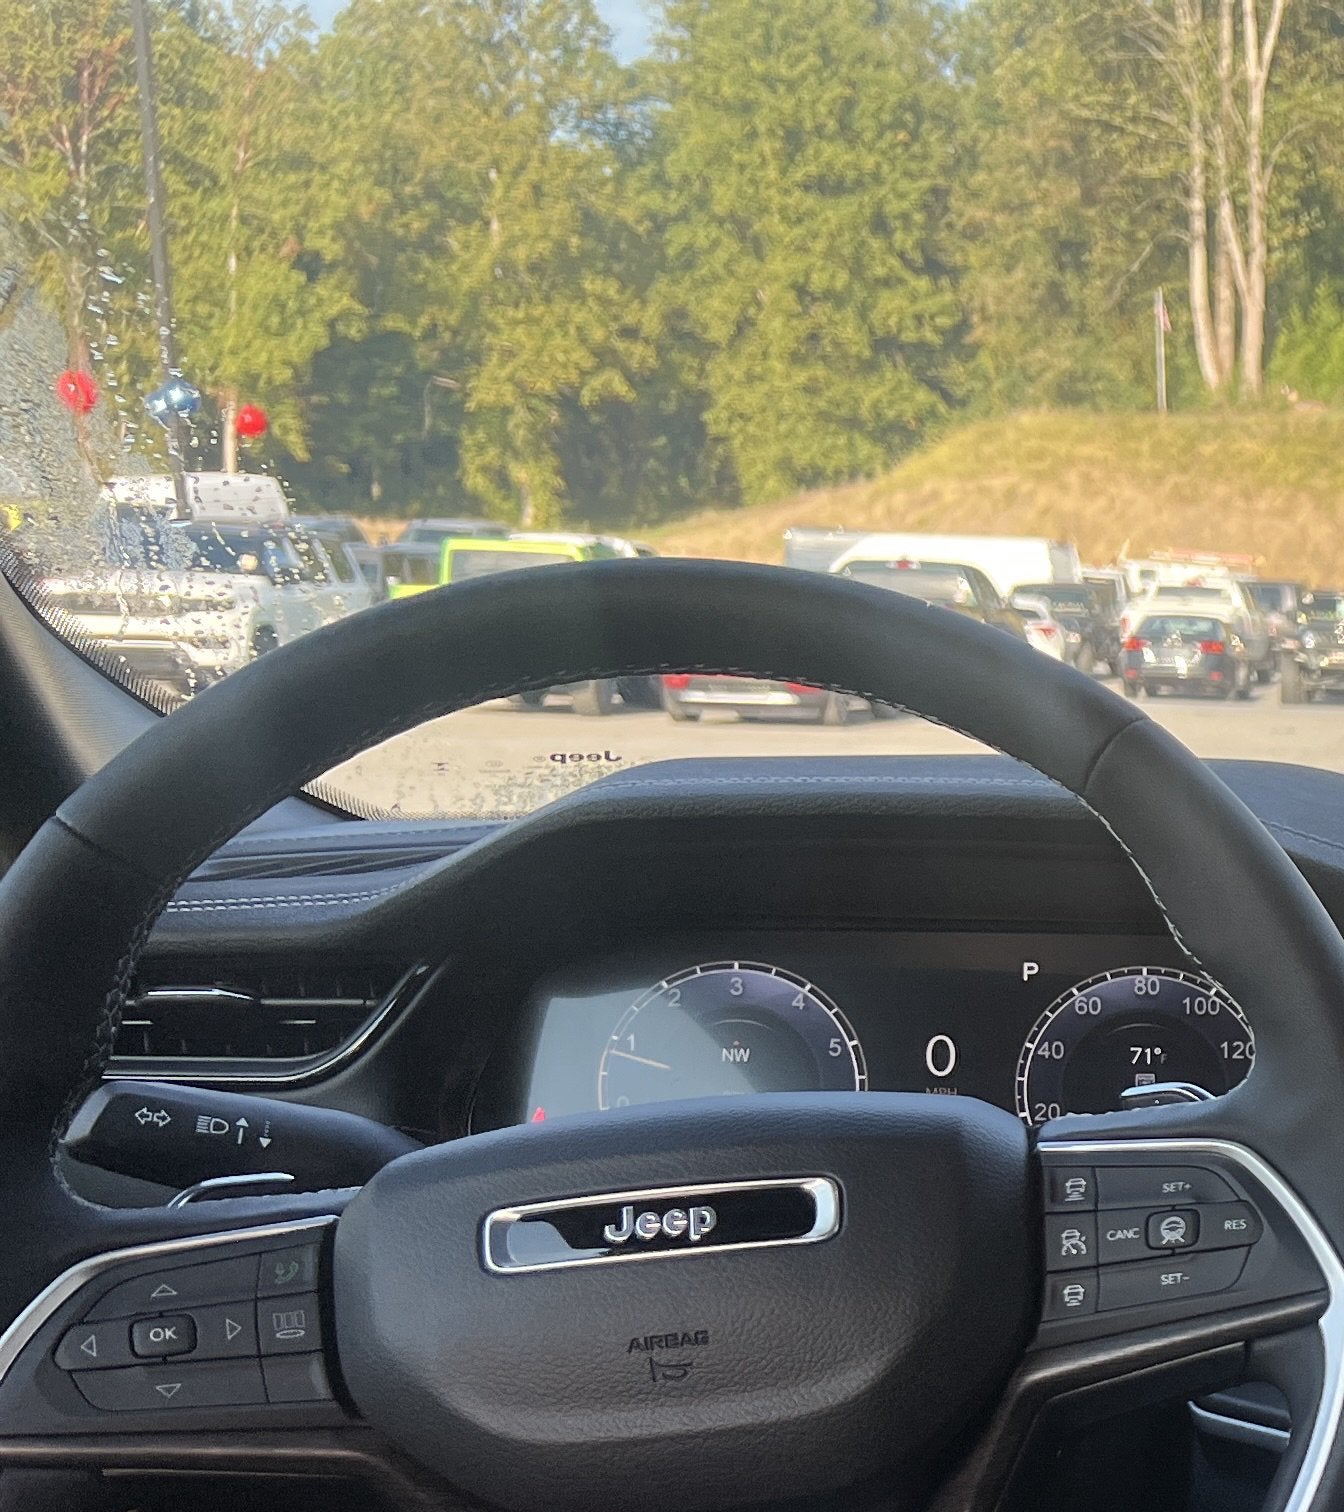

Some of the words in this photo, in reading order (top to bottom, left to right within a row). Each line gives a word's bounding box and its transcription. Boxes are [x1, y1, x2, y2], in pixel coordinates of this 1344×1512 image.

[1023, 963, 1039, 981] P
[730, 977, 744, 996] 3
[1134, 978, 1160, 996] 80
[668, 989, 681, 1007] 2
[792, 993, 805, 1010] 4
[1074, 997, 1102, 1015] 60
[1182, 998, 1220, 1015] 100
[626, 1034, 635, 1050] 1
[828, 1038, 842, 1057] 5
[1037, 1042, 1064, 1059] 40
[722, 1048, 750, 1062] NW
[926, 1035, 957, 1077] 0
[1035, 1104, 1061, 1121] 20
[603, 1205, 717, 1244] Jeep
[1224, 1219, 1247, 1230] RES
[1107, 1228, 1140, 1240] CANC
[150, 1326, 177, 1342] OK
[627, 1330, 709, 1354] AIRBAG
